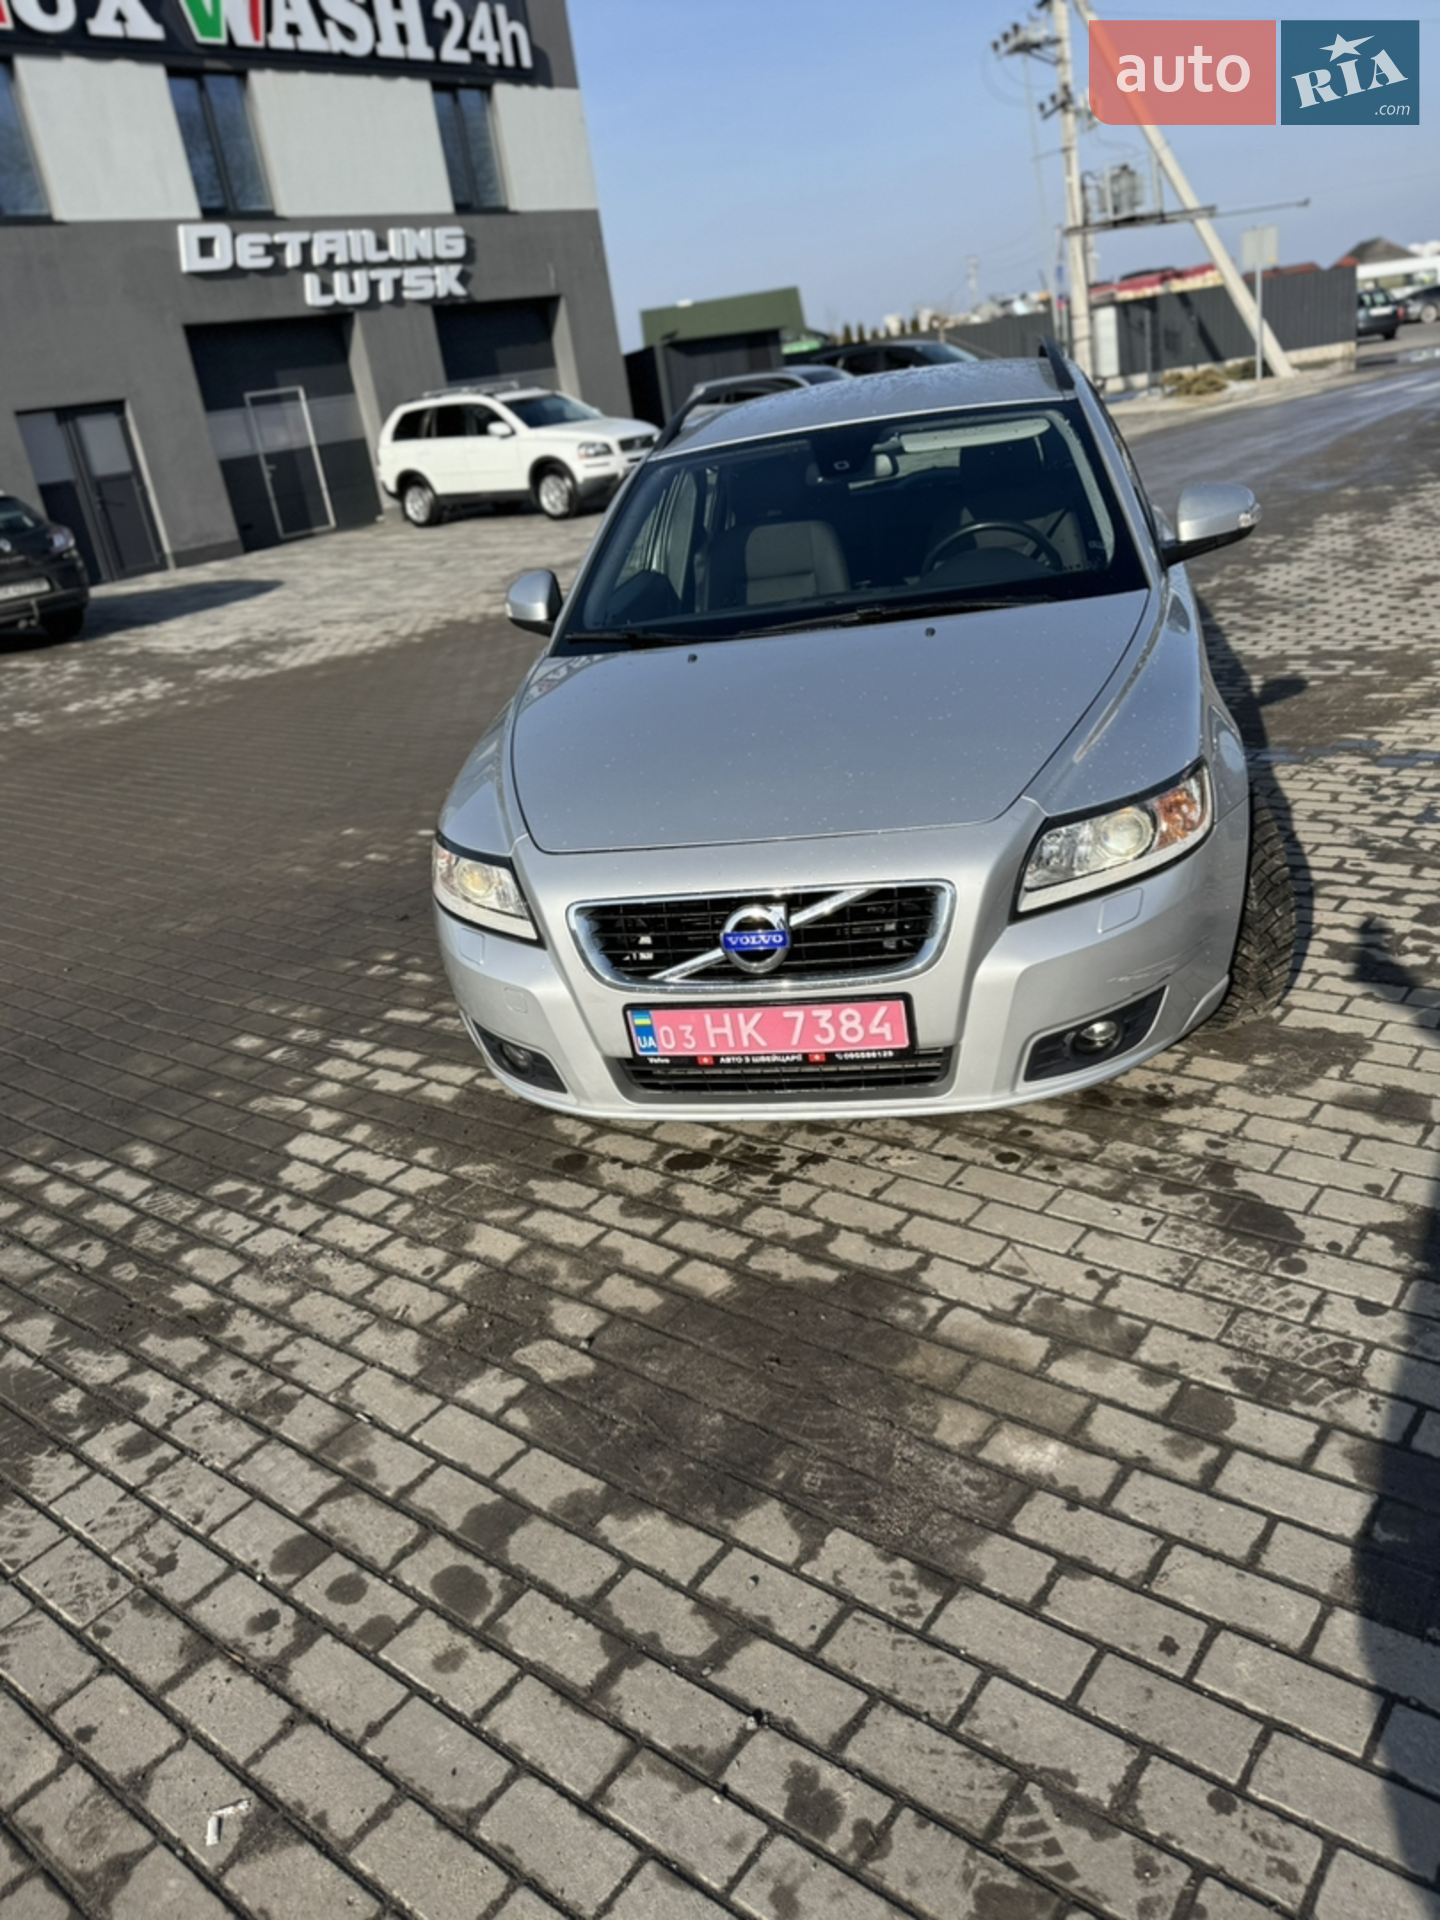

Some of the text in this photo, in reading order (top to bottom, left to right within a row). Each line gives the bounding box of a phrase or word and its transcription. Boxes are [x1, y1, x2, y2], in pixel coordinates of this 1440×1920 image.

[178, 0, 435, 60] WASH
[433, 0, 533, 68] 24h
[177, 223, 467, 273] DETAILING
[304, 264, 468, 307] LUTSK
[727, 934, 784, 946] VOLVO
[638, 1035, 658, 1049] UA
[659, 1025, 697, 1050] 03
[782, 1005, 894, 1046] 7384
